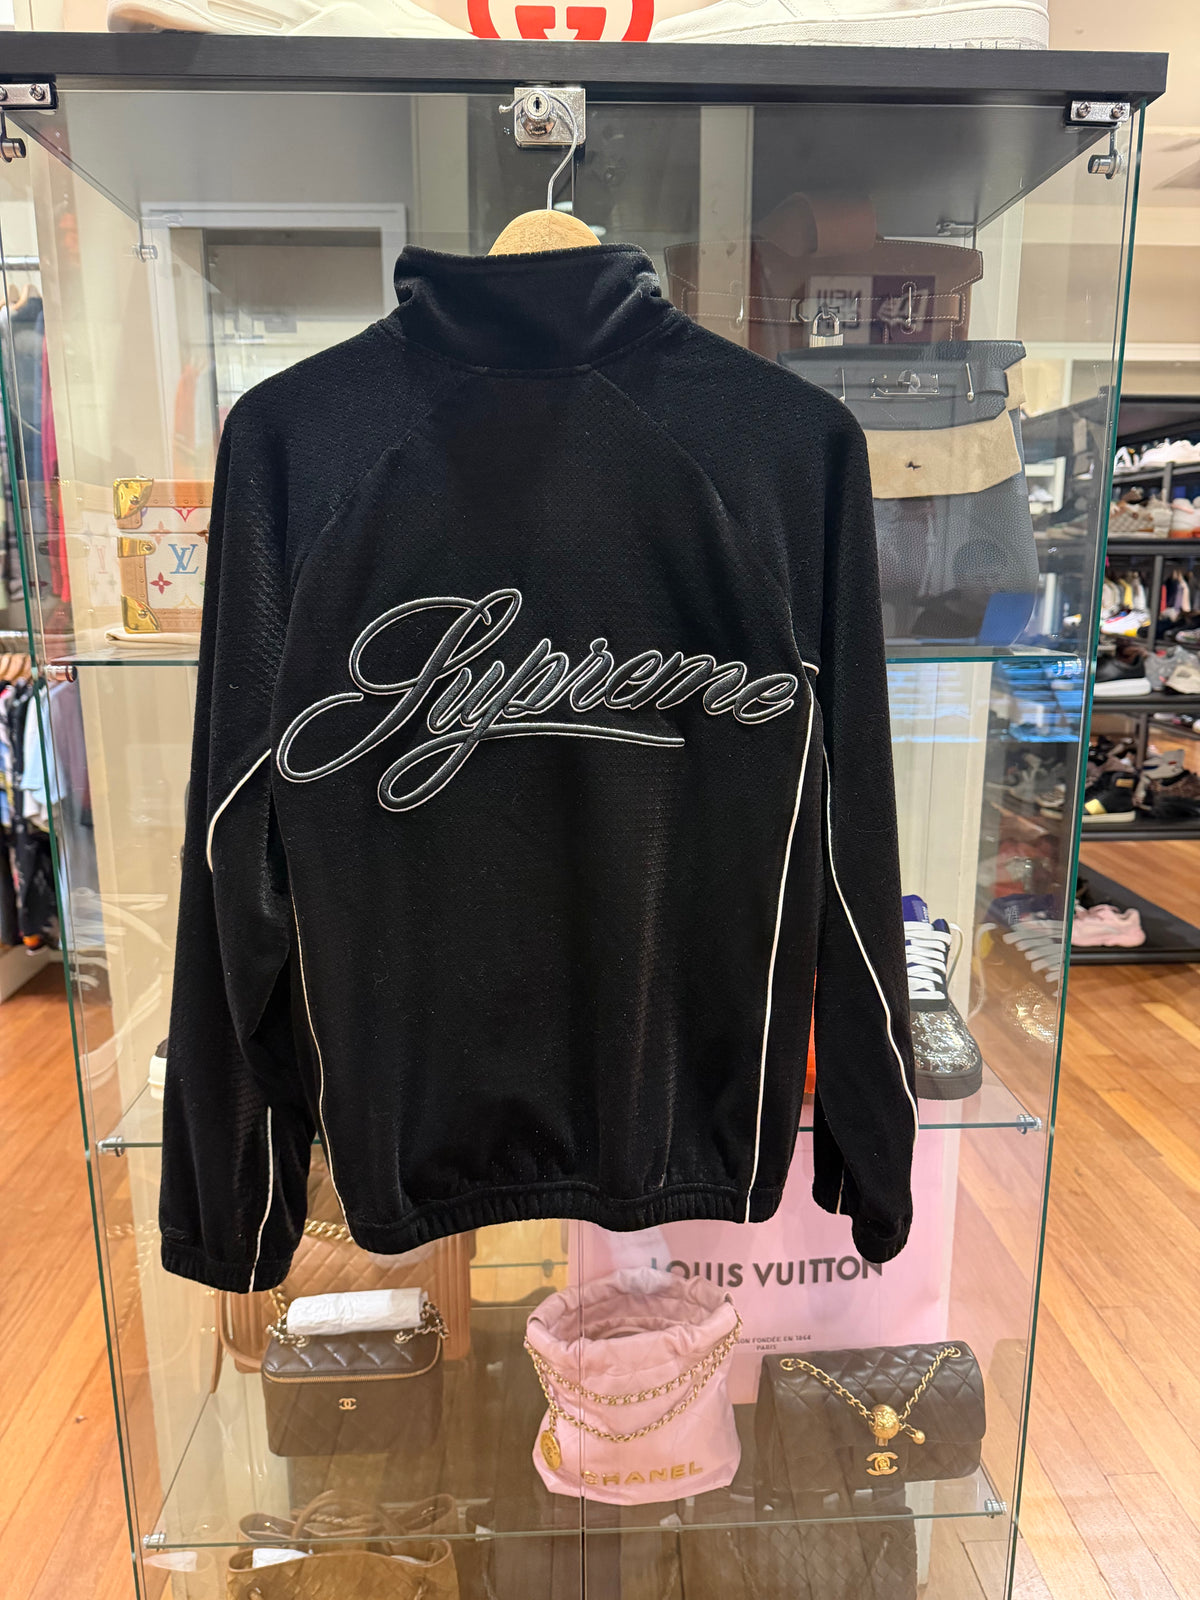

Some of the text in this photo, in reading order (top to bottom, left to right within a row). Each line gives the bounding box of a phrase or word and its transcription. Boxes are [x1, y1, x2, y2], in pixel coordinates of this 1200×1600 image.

[277, 588, 798, 812] Supreme
[753, 1256, 882, 1287] VUITTON
[581, 1461, 703, 1485] CHANEL
